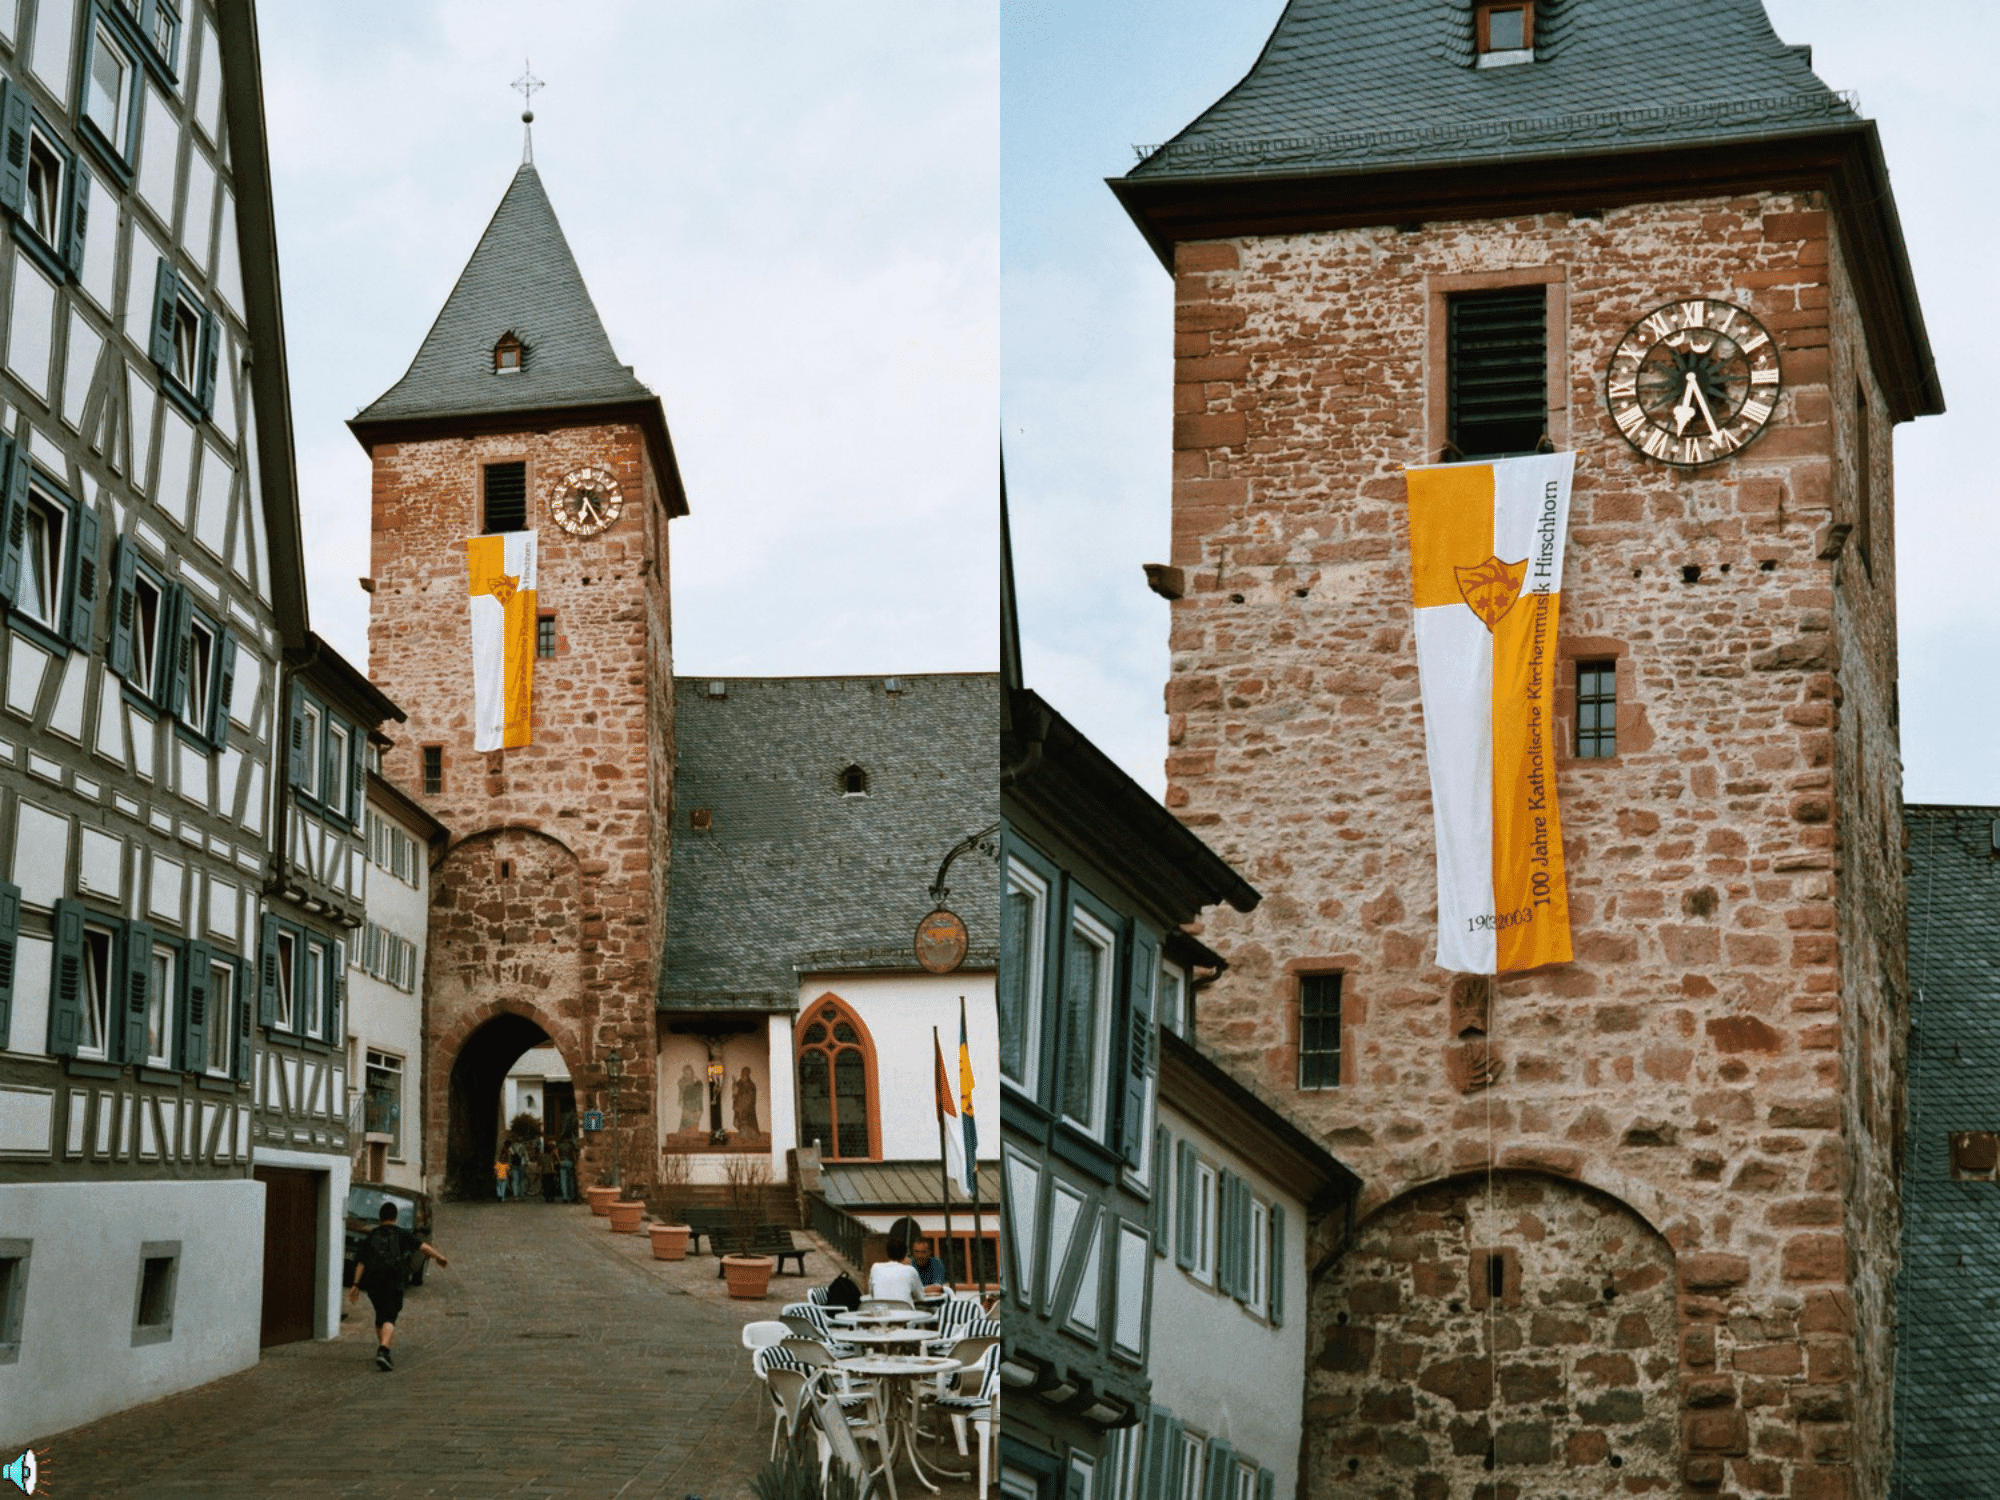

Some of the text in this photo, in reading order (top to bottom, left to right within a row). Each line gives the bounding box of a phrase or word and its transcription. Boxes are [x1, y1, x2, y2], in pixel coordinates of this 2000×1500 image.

[1527, 480, 1558, 907] 100 Jahre Katholische Kirchenmusik Hirschhorn
